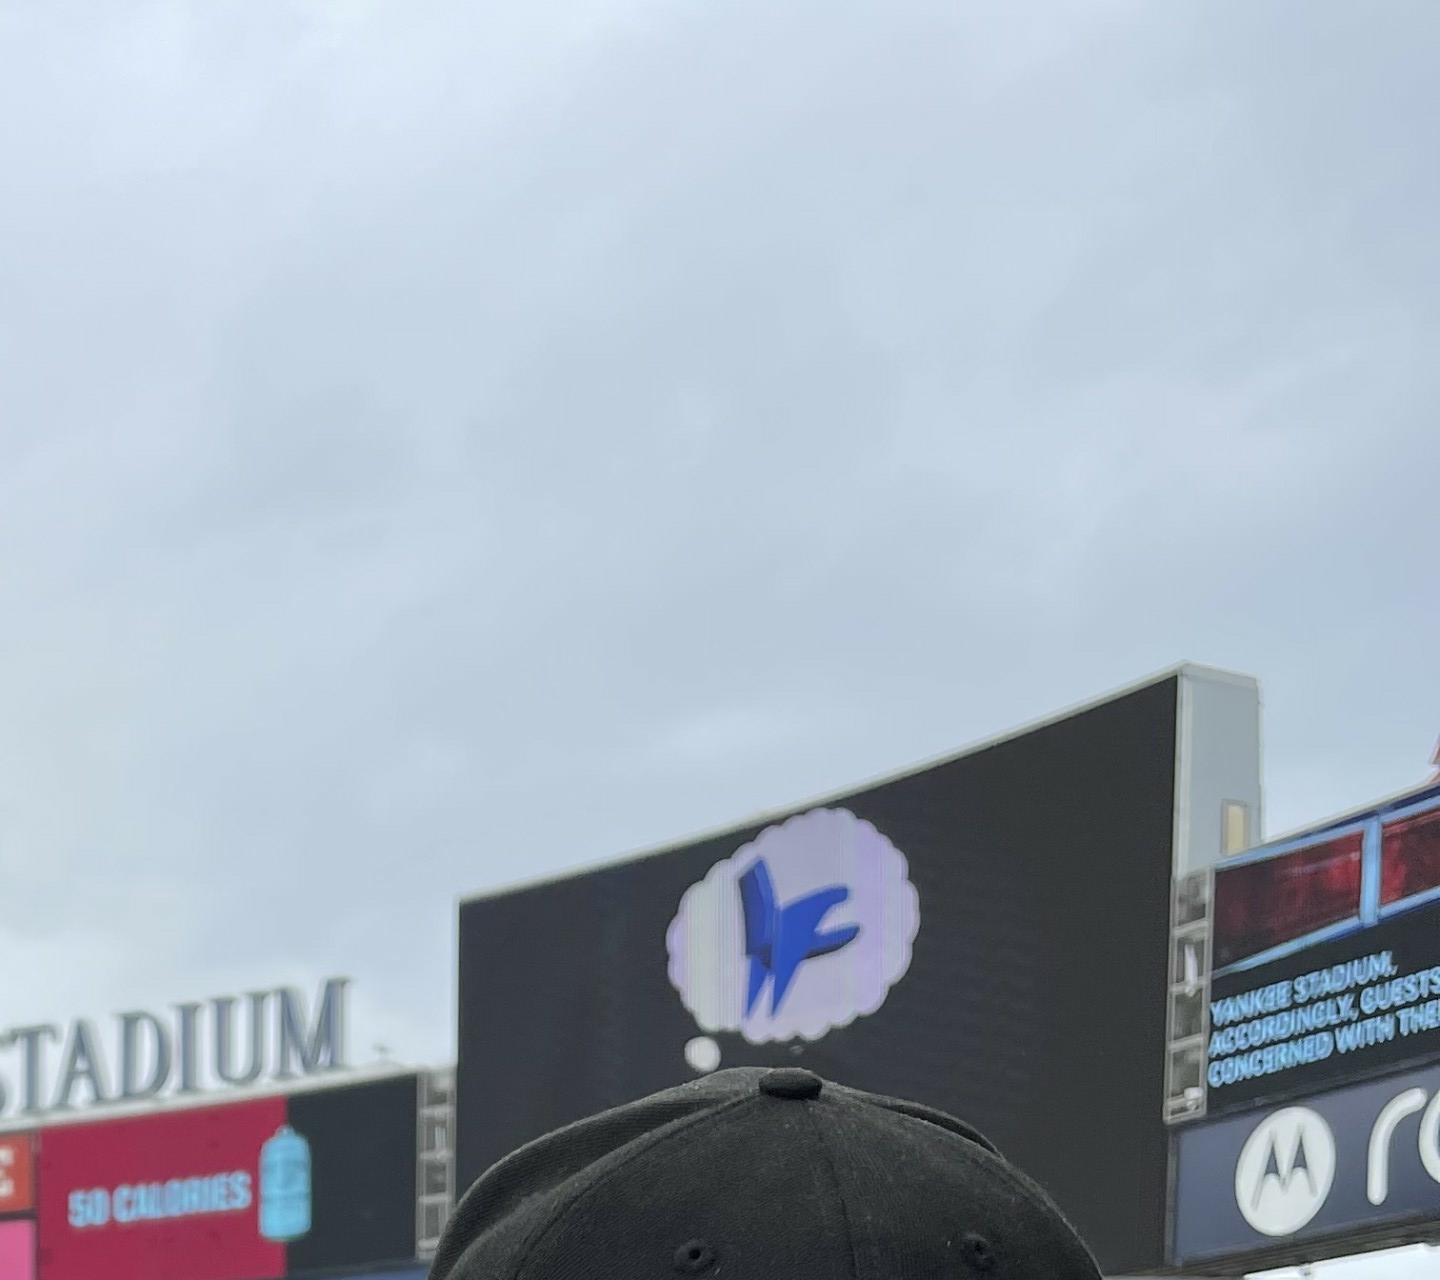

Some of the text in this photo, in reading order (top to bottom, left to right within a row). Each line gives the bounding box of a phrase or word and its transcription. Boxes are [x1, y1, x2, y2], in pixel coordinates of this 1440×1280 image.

[1209, 966, 1440, 1058] ACCORDINGLY, GUESTS
[1210, 980, 1292, 1027] YANKEE
[1208, 999, 1440, 1088] CONCERNED WITH THE
[68, 1189, 110, 1228] 50
